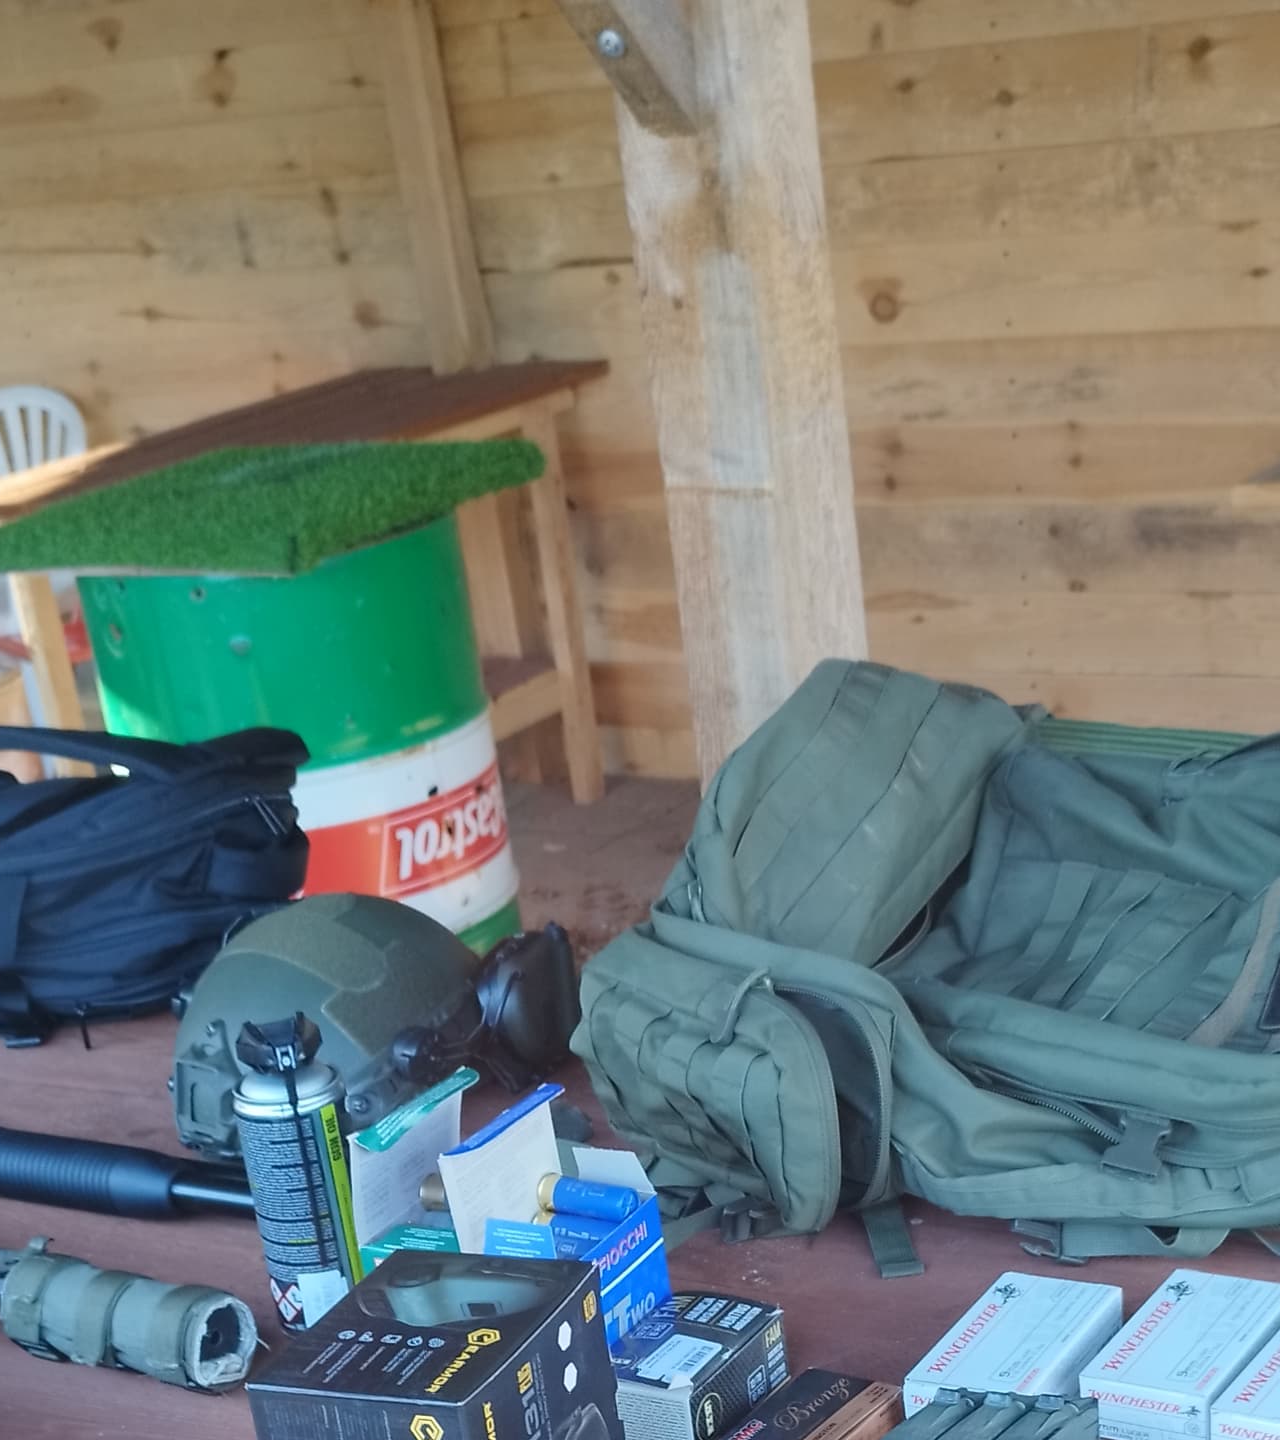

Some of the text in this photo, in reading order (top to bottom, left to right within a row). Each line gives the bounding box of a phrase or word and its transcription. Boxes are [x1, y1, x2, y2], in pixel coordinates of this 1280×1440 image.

[599, 1220, 648, 1278] FIOCCHI
[765, 1319, 782, 1348] FAM
[927, 1303, 1001, 1374] WINCHESTER
[1102, 1299, 1176, 1371] WINCHESTER
[773, 1378, 851, 1431] Bronze
[1088, 1389, 1181, 1414] WINCHESTER
